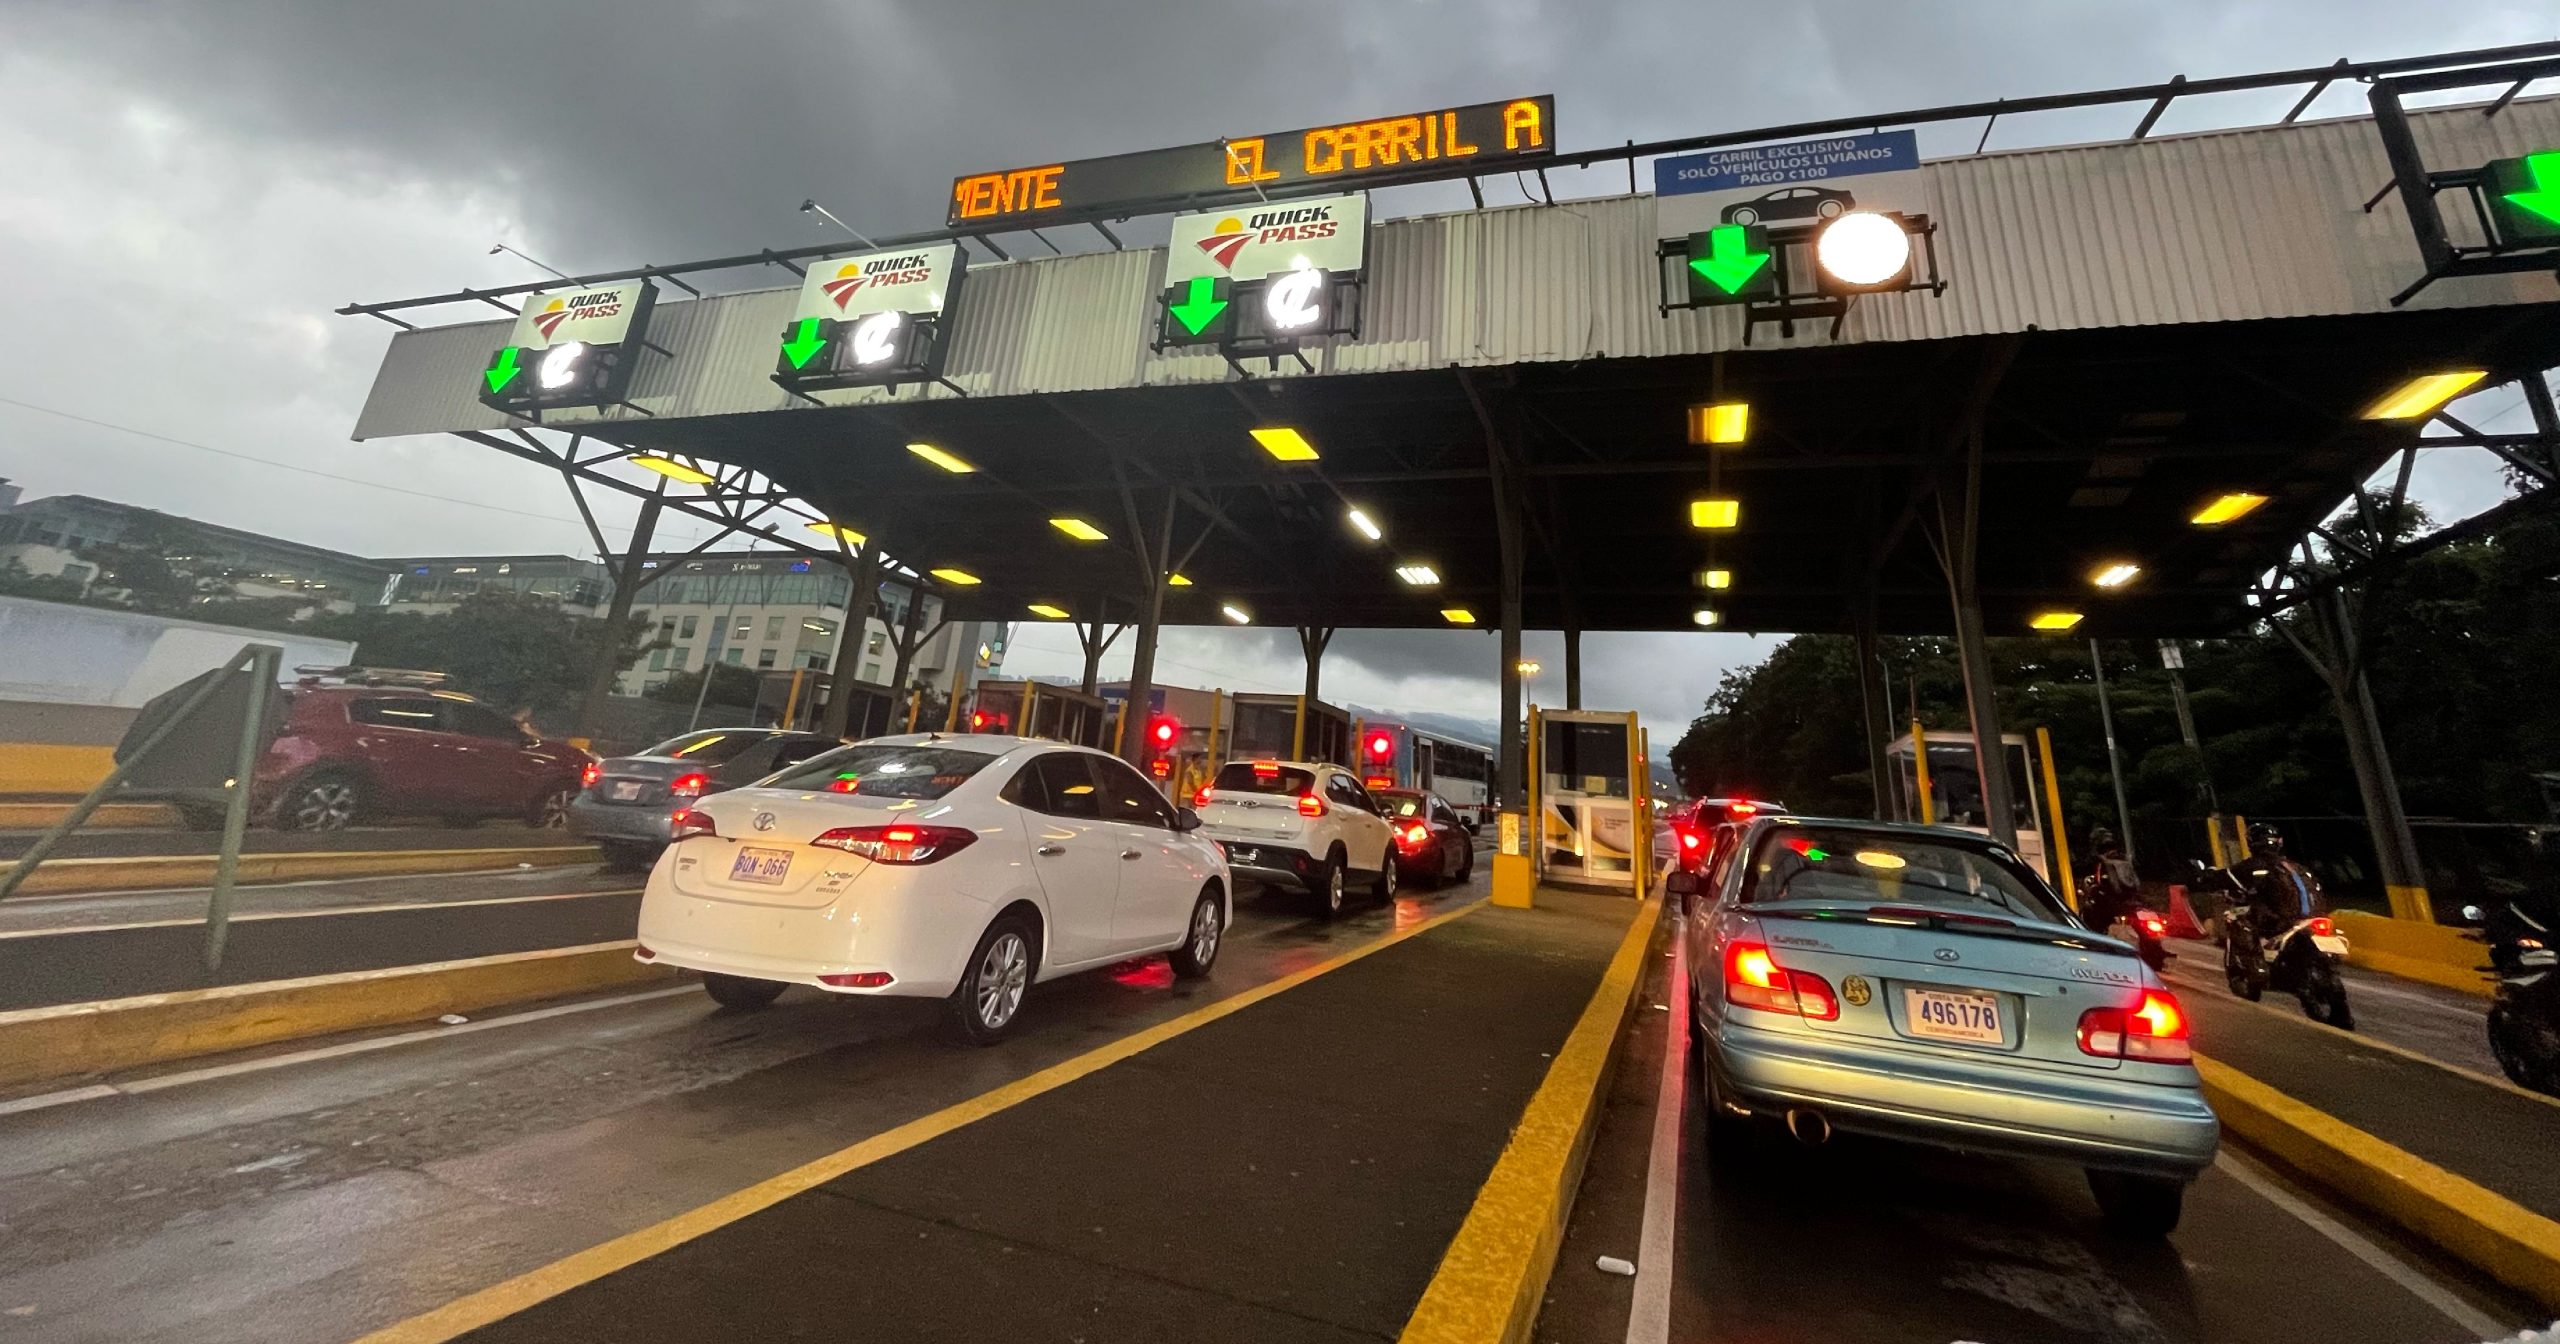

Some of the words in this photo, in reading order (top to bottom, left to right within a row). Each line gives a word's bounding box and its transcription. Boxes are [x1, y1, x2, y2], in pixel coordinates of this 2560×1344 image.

[1225, 137, 1281, 185] EL
[1303, 112, 1479, 175] CARRIL
[1503, 100, 1543, 150] A
[1708, 150, 1764, 166] CARRIL
[1767, 139, 1856, 159] EXCLUSIVO
[1677, 166, 1719, 181] SOLO
[1721, 156, 1811, 175] VEHÍCULOS
[1814, 147, 1893, 165] LIVIANOS
[1740, 171, 1785, 185] PAGO
[1249, 205, 1333, 230] QUICK
[1259, 221, 1339, 244] PASS
[863, 253, 930, 275] QUICK
[869, 267, 932, 288] PASS
[567, 290, 622, 309] QUICK
[570, 303, 623, 321] PASS
[1921, 999, 1996, 1031] 496178
